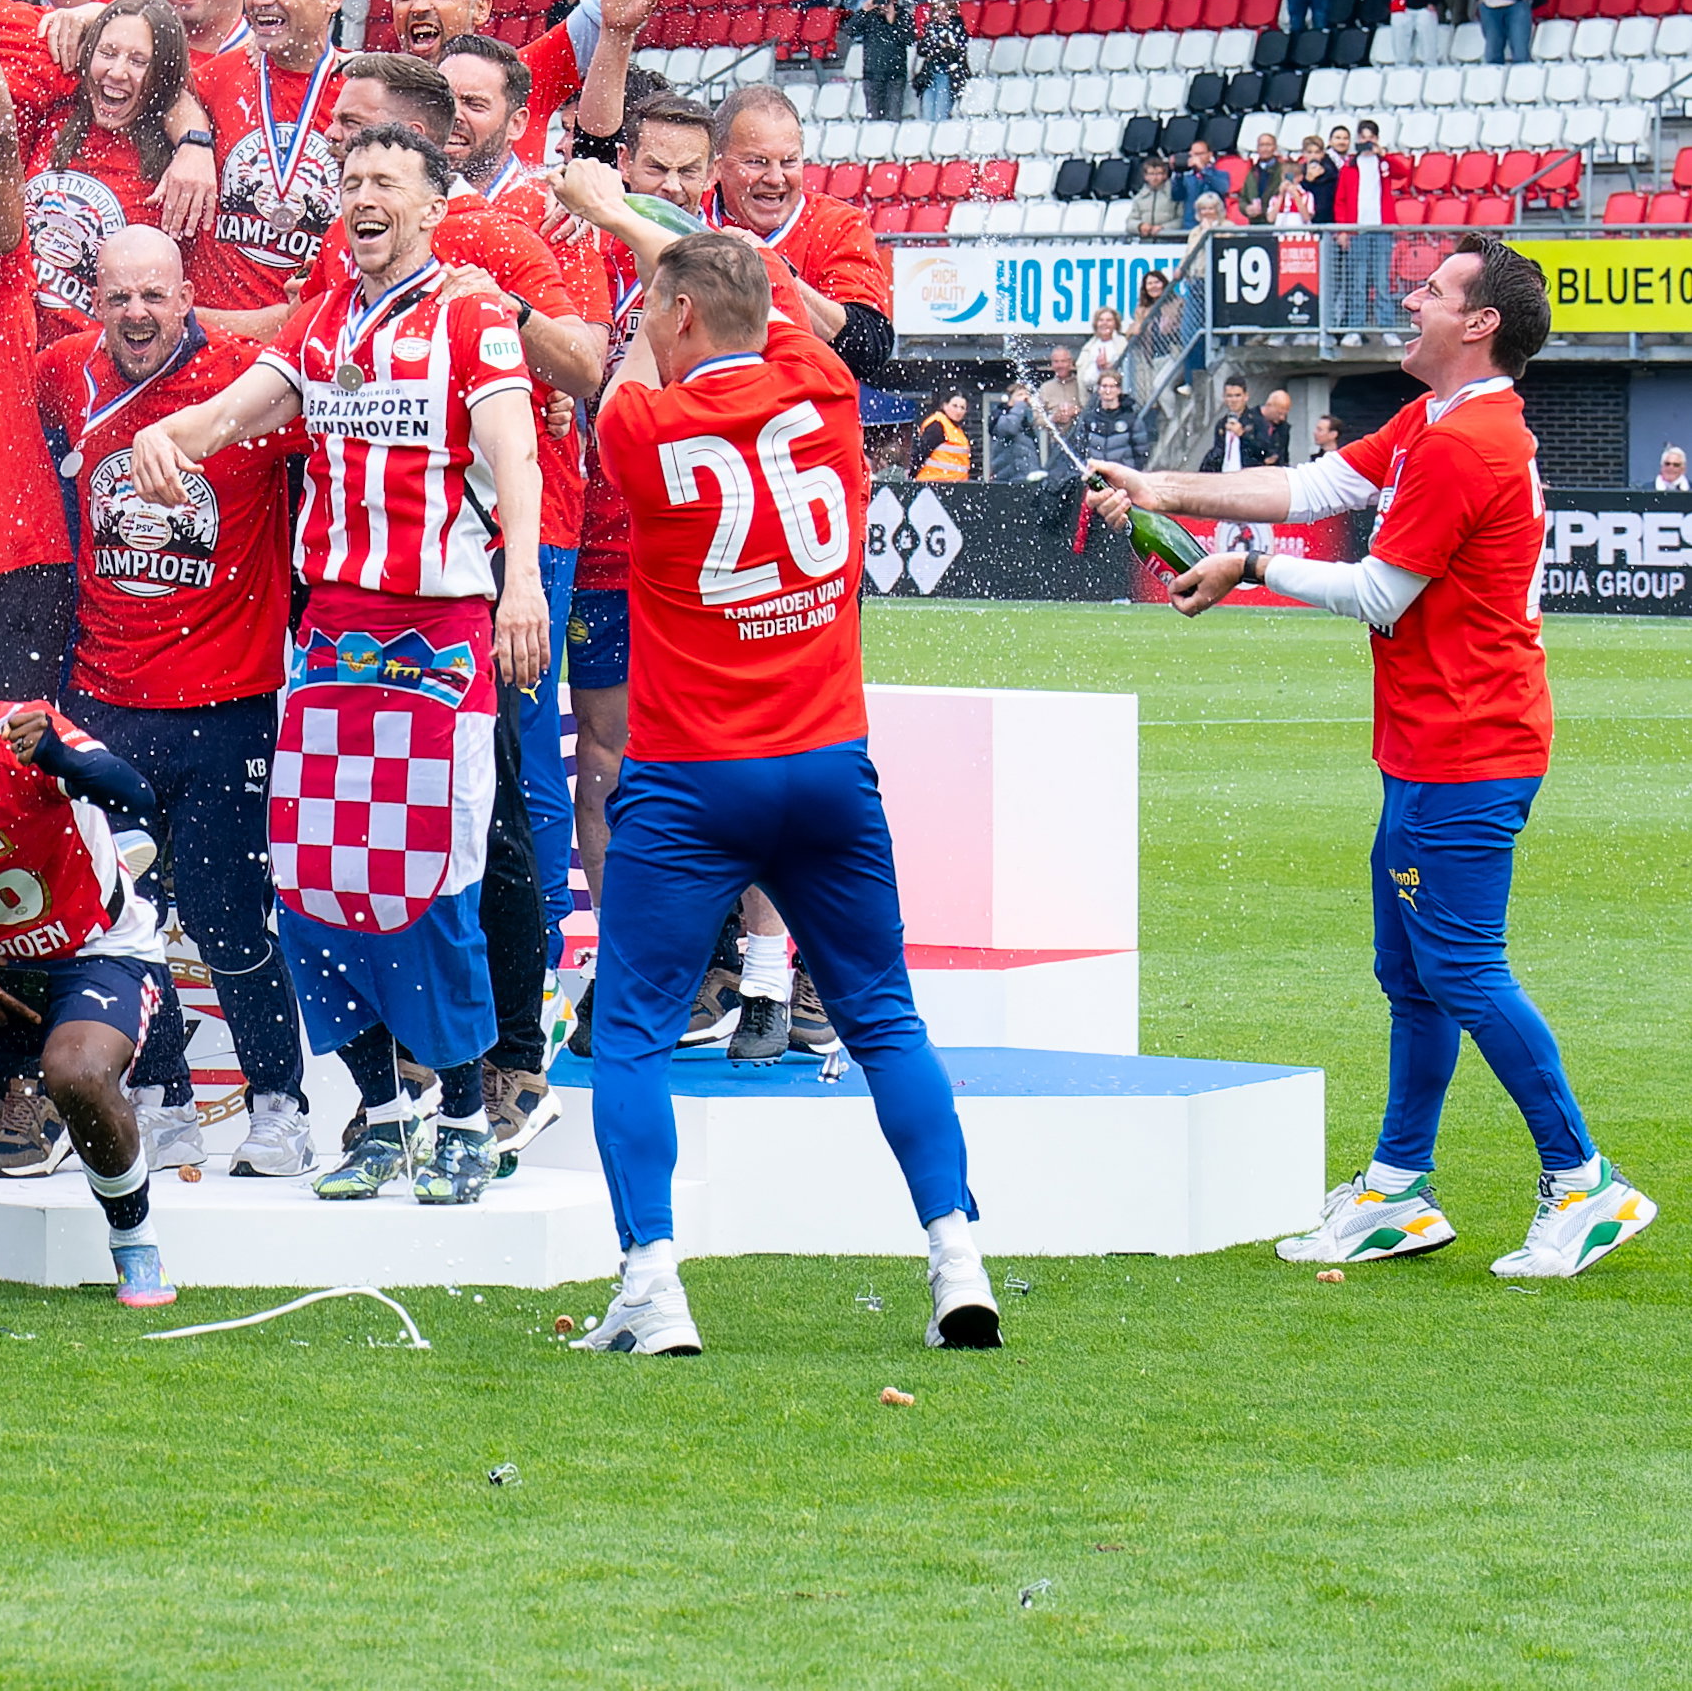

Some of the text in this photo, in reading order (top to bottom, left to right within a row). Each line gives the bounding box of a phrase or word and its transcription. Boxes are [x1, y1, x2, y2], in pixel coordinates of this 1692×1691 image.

[236, 138, 263, 162] PSV
[25, 178, 50, 202] PSV
[214, 213, 323, 260] KAMPIOE
[1218, 246, 1272, 304] 19
[483, 341, 520, 357] TOTO
[309, 398, 429, 417] BRAINPORT
[93, 464, 115, 494] PSV
[658, 400, 851, 607] 26
[134, 522, 154, 534] PSV
[92, 548, 217, 588] KAMPIOEN
[1596, 568, 1686, 598] GROUP
[723, 576, 845, 620] KAMPIOEN VAN
[737, 603, 837, 641] NEDERLAND
[245, 757, 267, 778] KB
